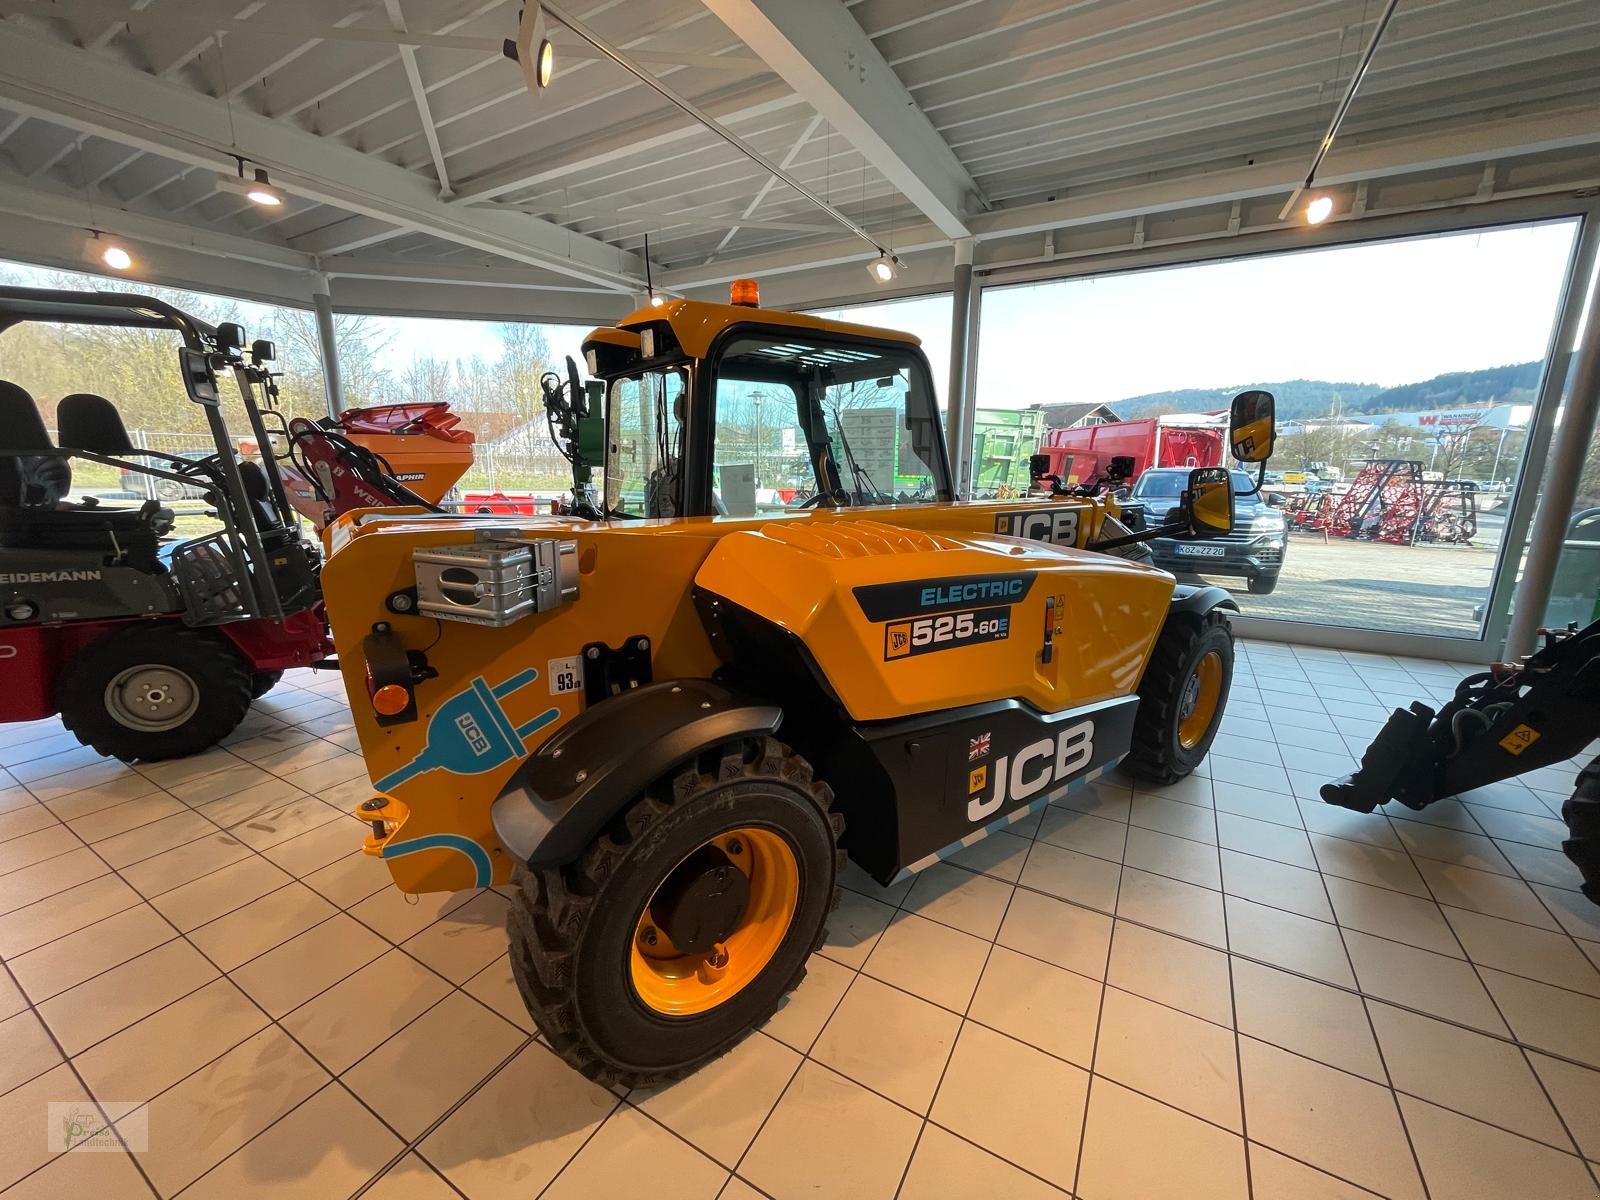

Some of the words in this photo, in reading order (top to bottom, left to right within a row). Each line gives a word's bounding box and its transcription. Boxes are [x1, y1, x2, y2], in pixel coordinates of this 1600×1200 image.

[921, 579, 1023, 606] ELECTRIC
[557, 672, 574, 691] 93
[458, 715, 488, 752] JCB
[967, 720, 1095, 822] JCB
